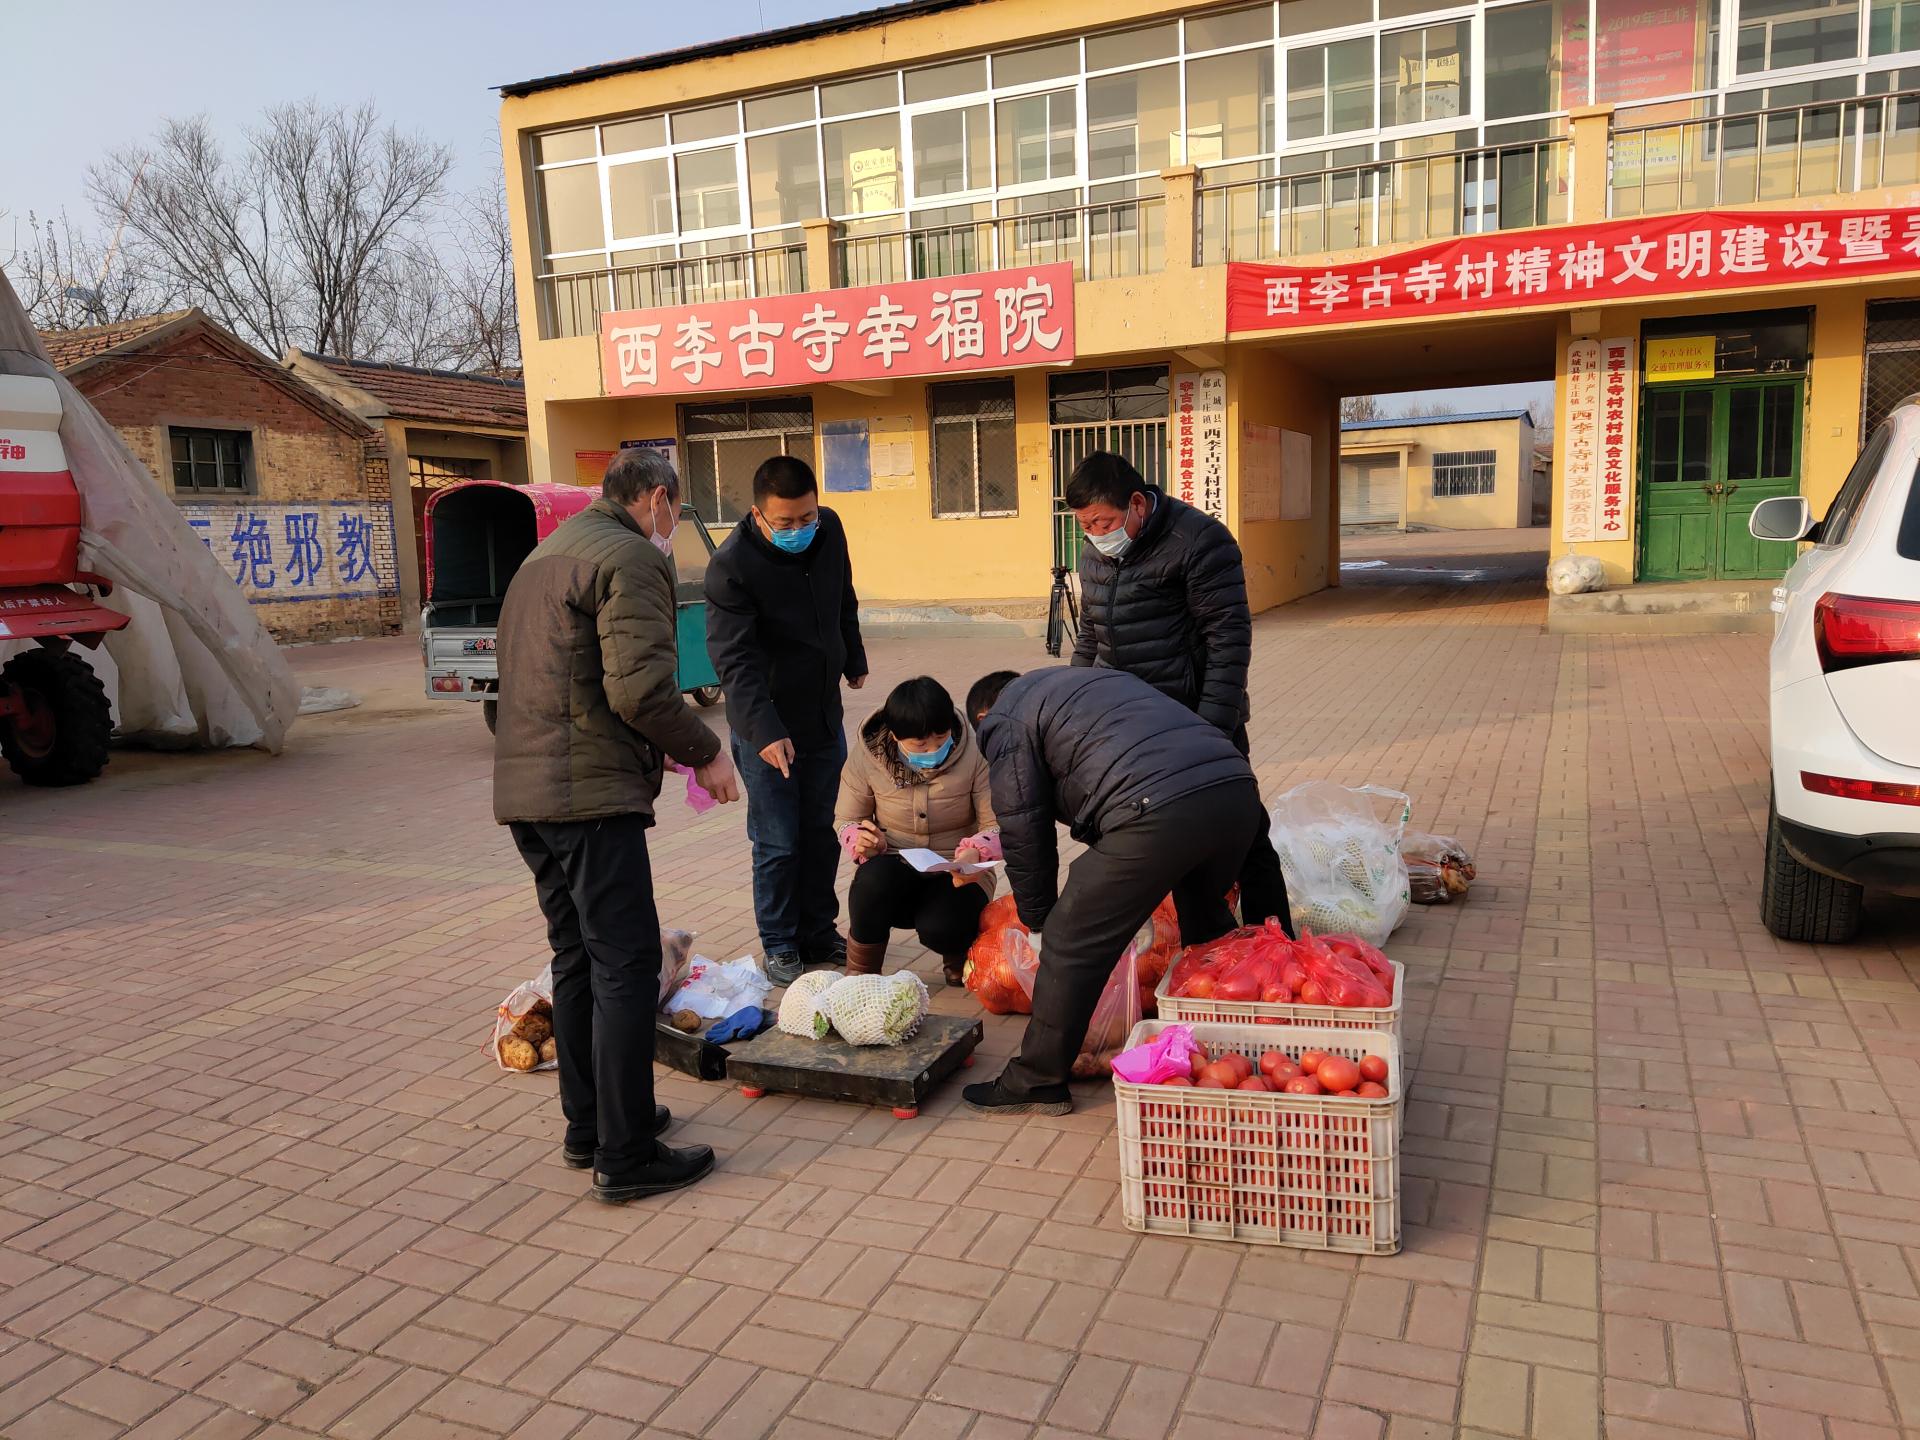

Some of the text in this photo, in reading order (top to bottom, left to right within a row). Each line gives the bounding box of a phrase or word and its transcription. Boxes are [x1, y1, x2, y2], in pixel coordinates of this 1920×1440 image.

[609, 276, 1063, 388] 西李古寺幸福院
[1603, 346, 1626, 531] 西李古寺村农村综合文化服务中心
[188, 512, 380, 589] 绝邪教
